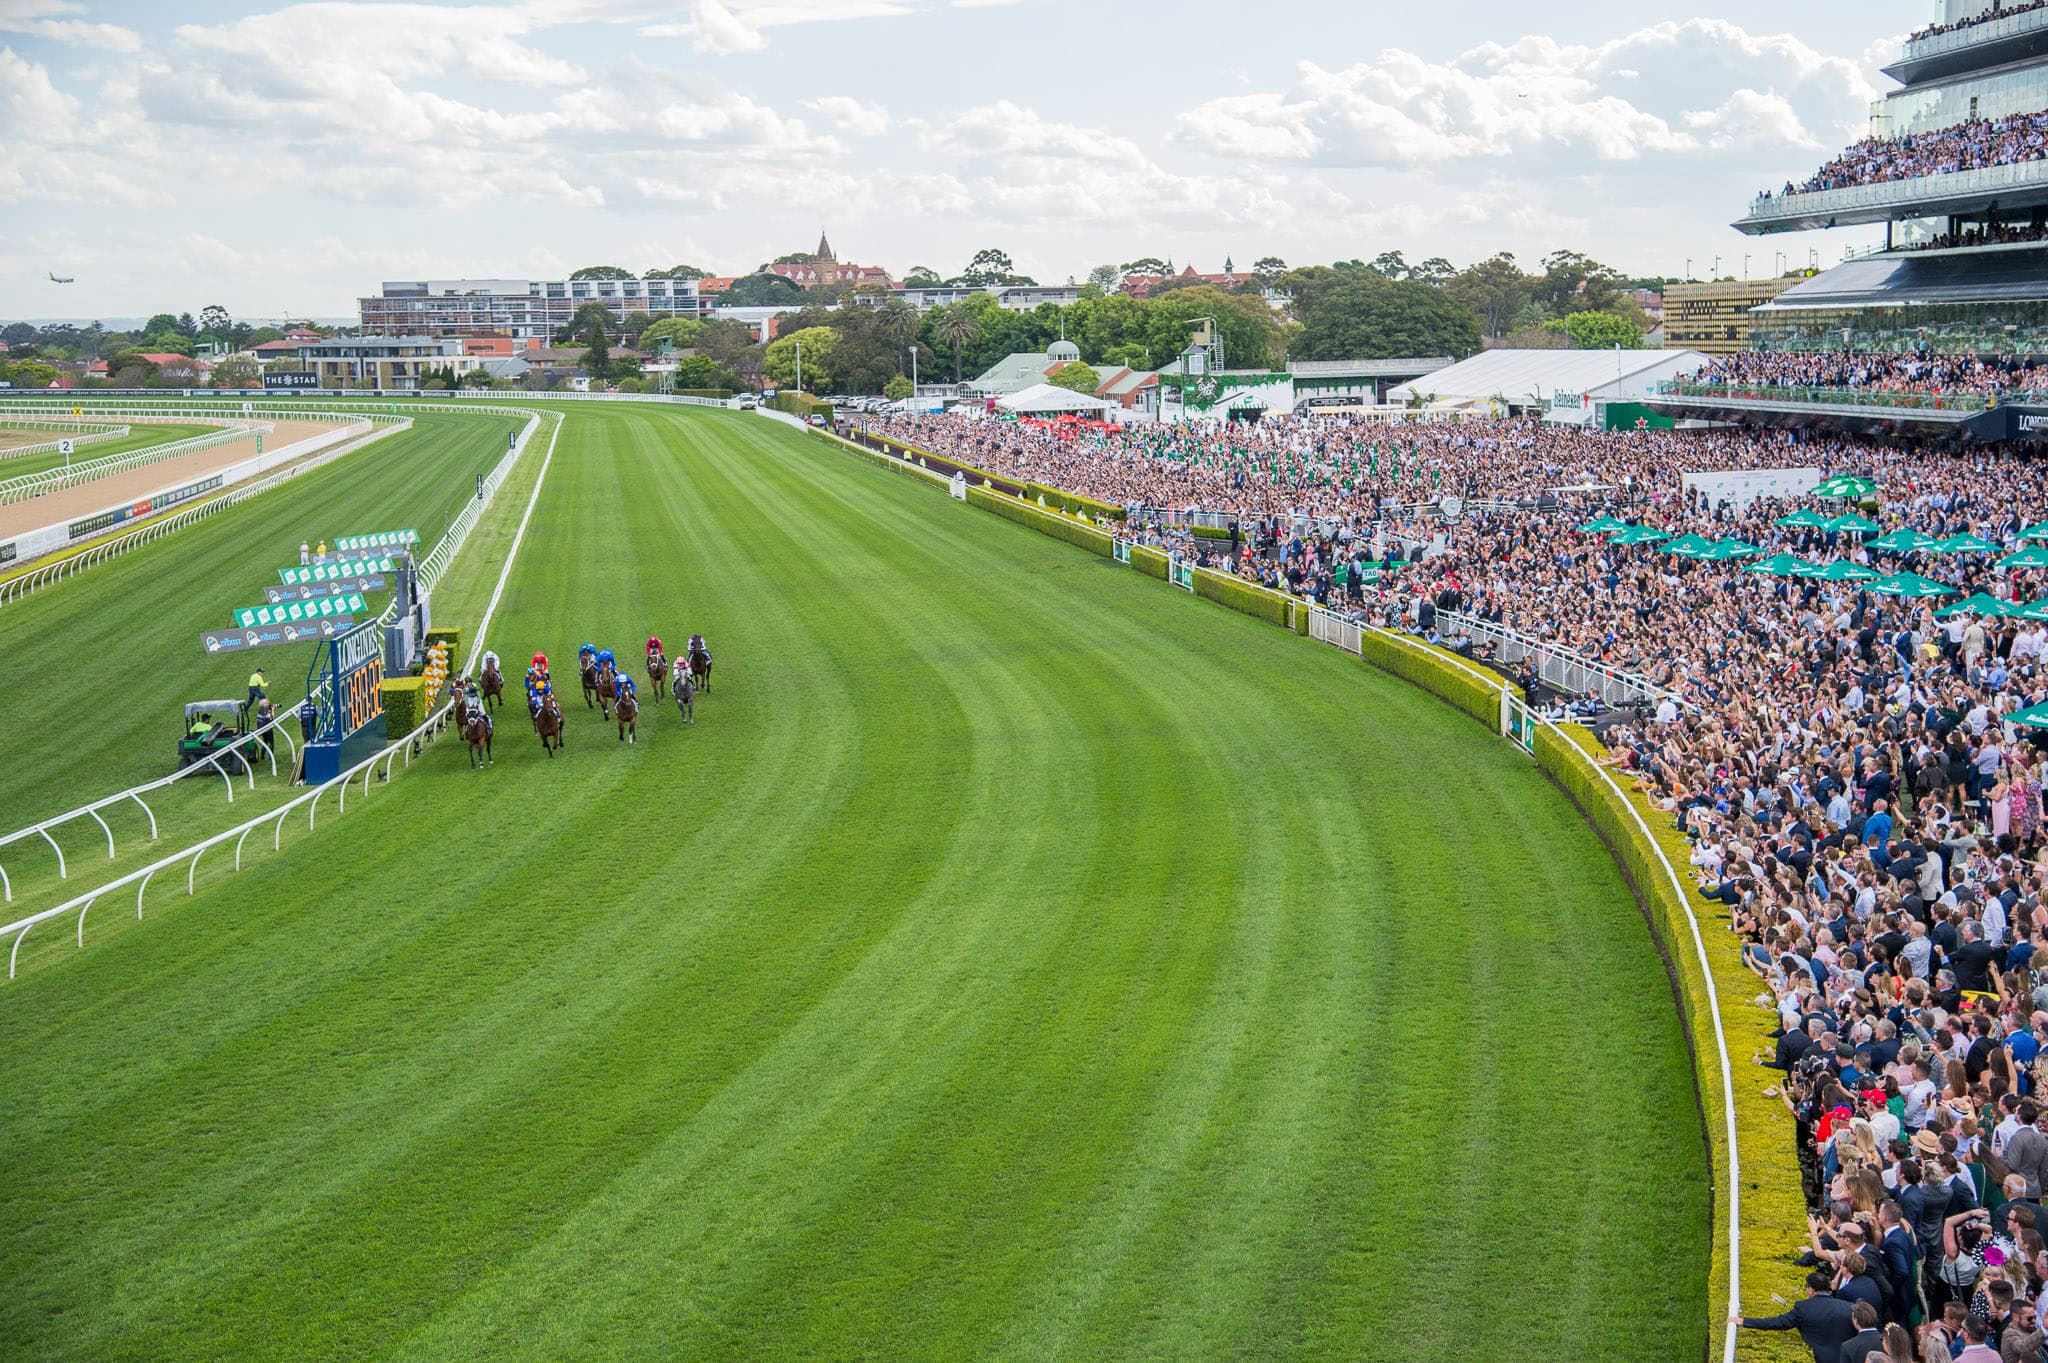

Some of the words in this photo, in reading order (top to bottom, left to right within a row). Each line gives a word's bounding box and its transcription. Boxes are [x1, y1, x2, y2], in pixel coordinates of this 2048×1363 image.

[265, 376, 282, 384] THE
[293, 376, 316, 384] STAR
[1554, 388, 1581, 409] Heineken
[63, 441, 70, 451] 2
[337, 623, 378, 674] LONGINES
